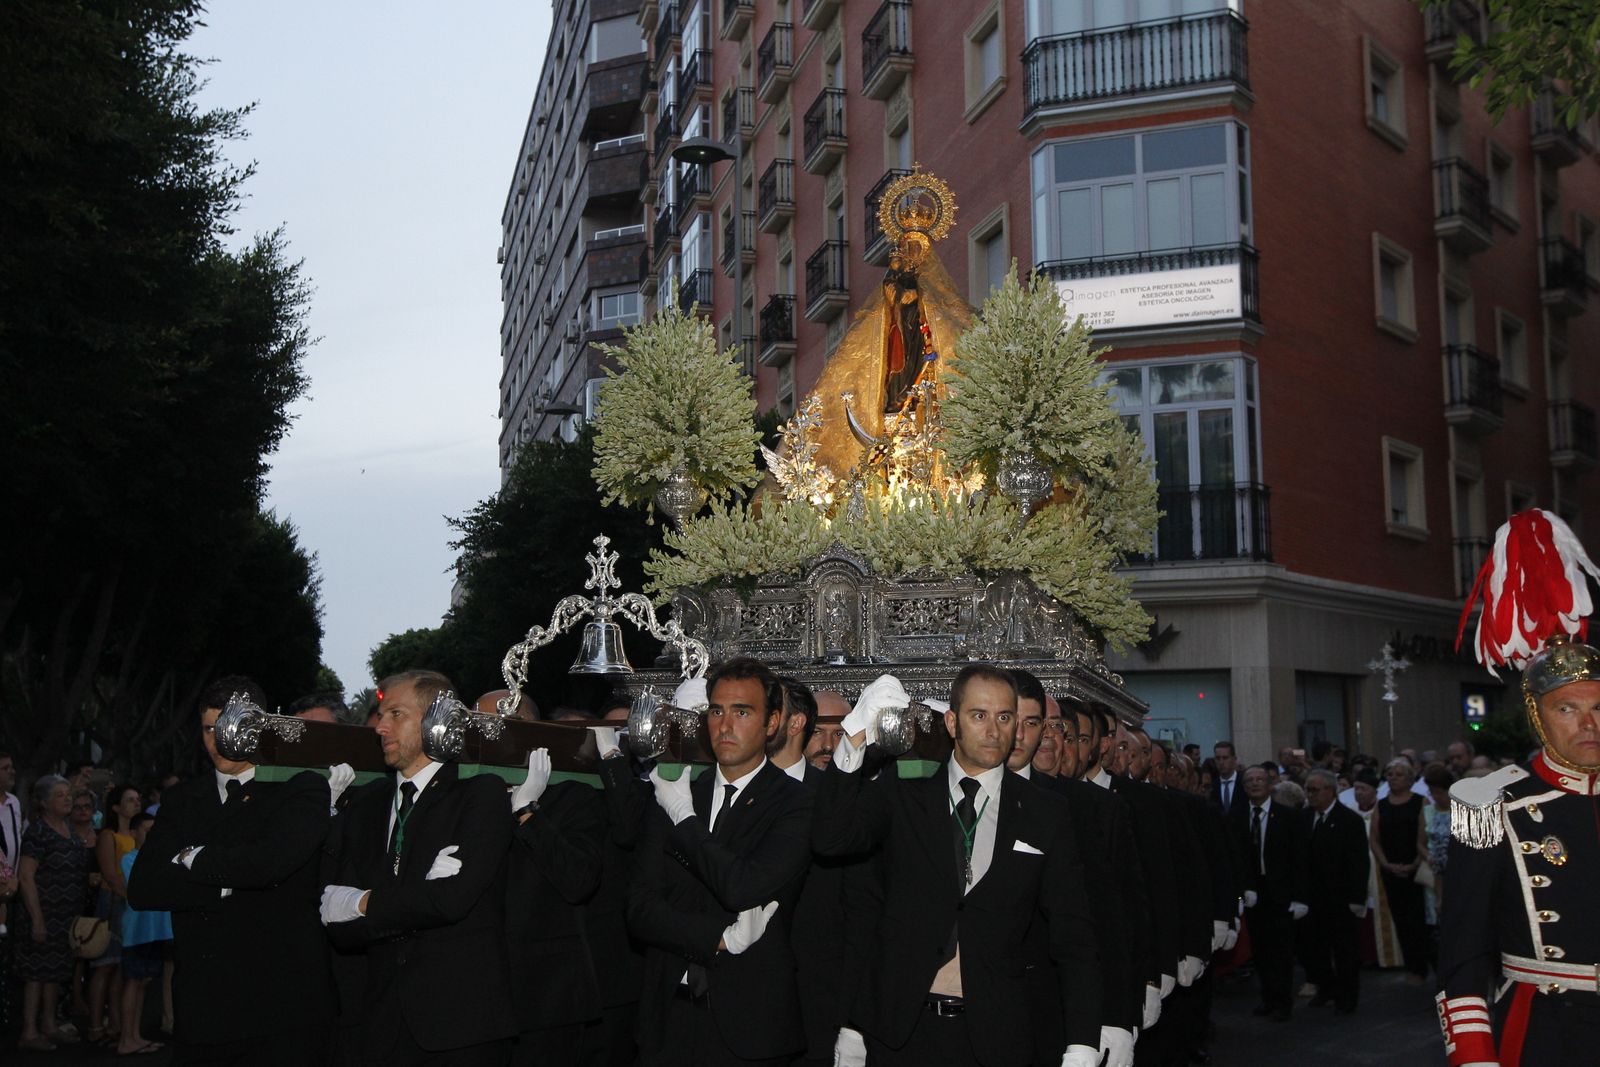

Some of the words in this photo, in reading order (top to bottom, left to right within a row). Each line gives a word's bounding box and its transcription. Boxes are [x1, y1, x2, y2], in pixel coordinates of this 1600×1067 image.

[1152, 281, 1197, 290] PROFESIONAL
[1199, 278, 1234, 286] AVANZADA
[1185, 287, 1211, 295] IMAGEN
[1173, 308, 1234, 318] www.daimagen.es
